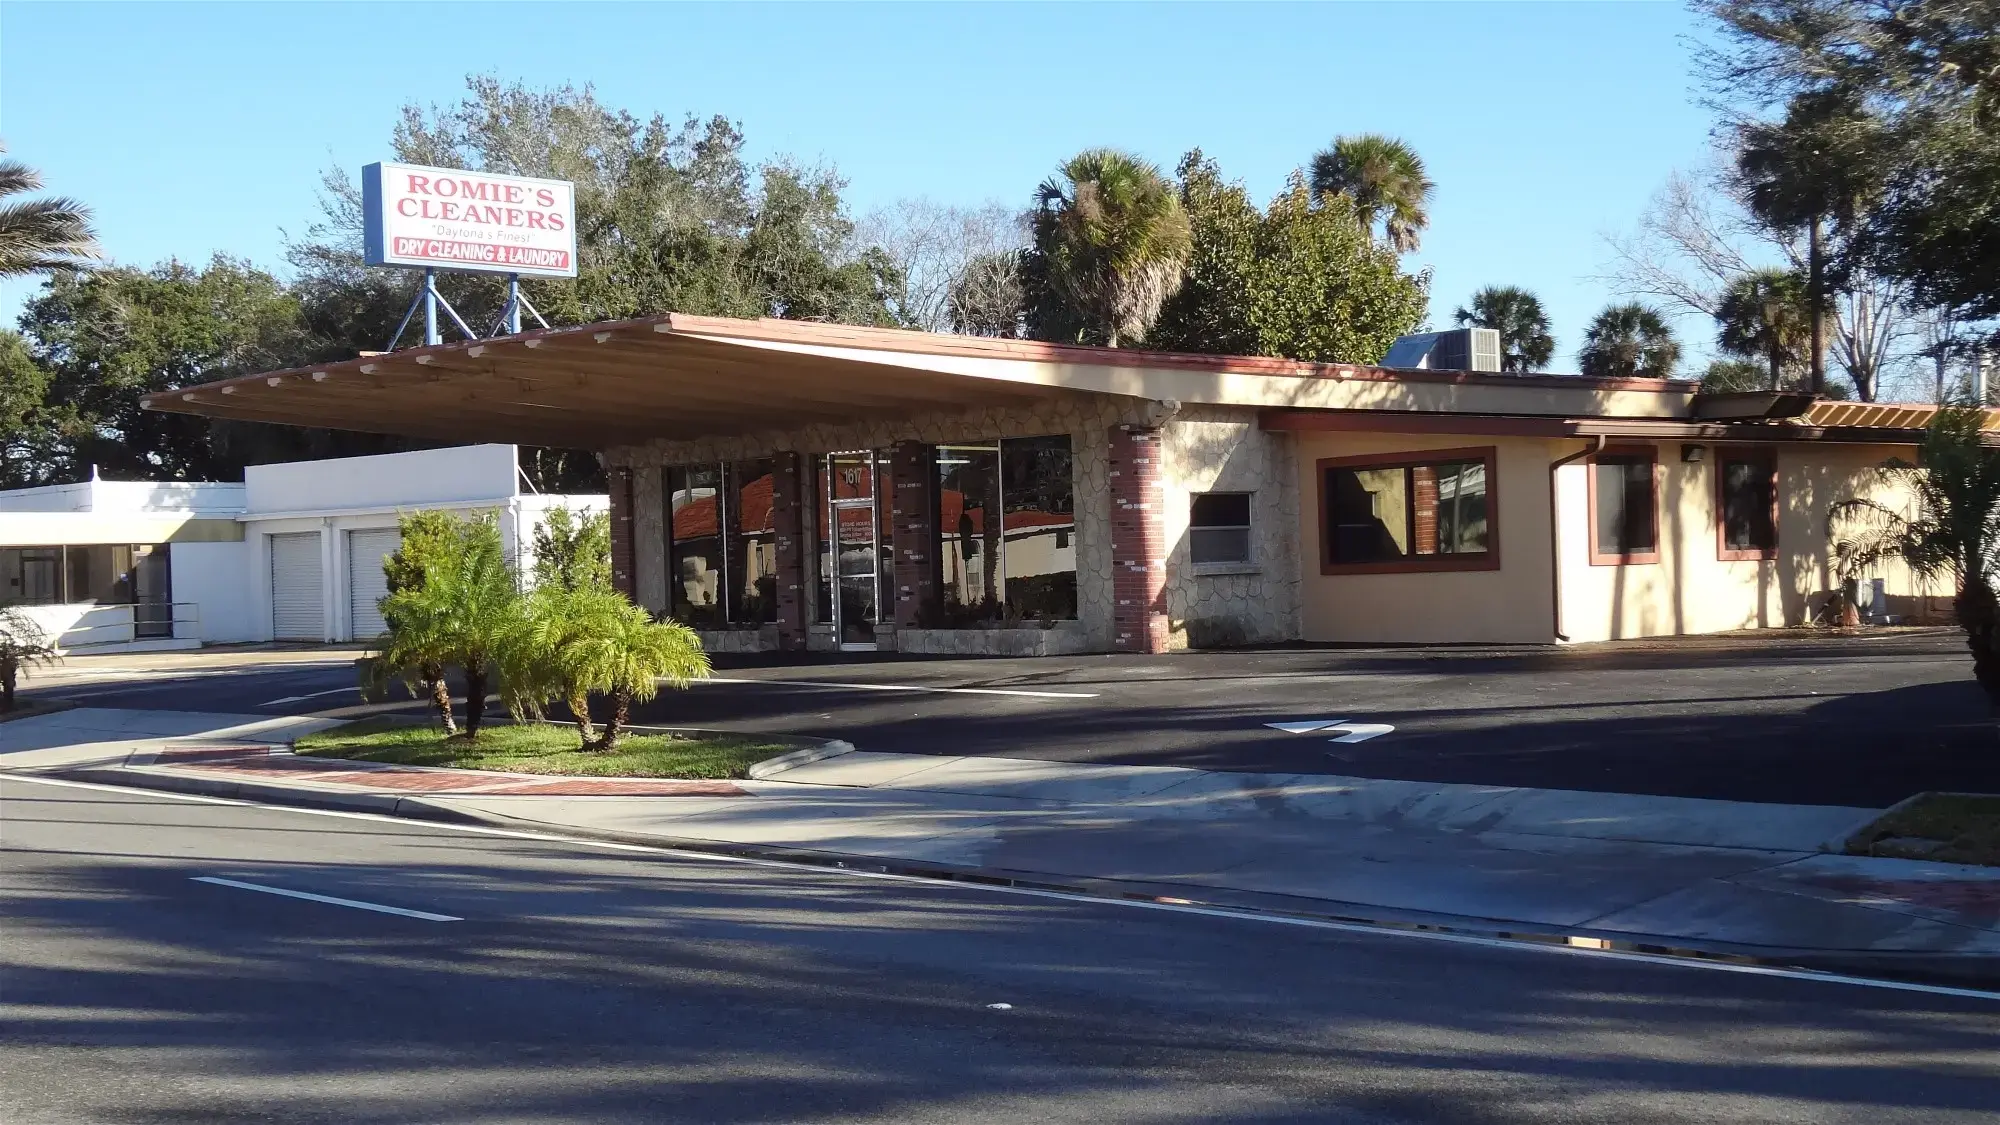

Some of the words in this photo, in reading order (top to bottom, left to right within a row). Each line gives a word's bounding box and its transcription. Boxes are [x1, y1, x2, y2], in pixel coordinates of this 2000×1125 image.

[407, 174, 555, 207] ROMIE'S
[397, 197, 565, 231] CLEANERS
[398, 238, 424, 255] DRY
[427, 240, 494, 262] CLEANING
[496, 250, 507, 263] &
[509, 250, 565, 267] LAUNDRY
[844, 467, 862, 484] 1617
